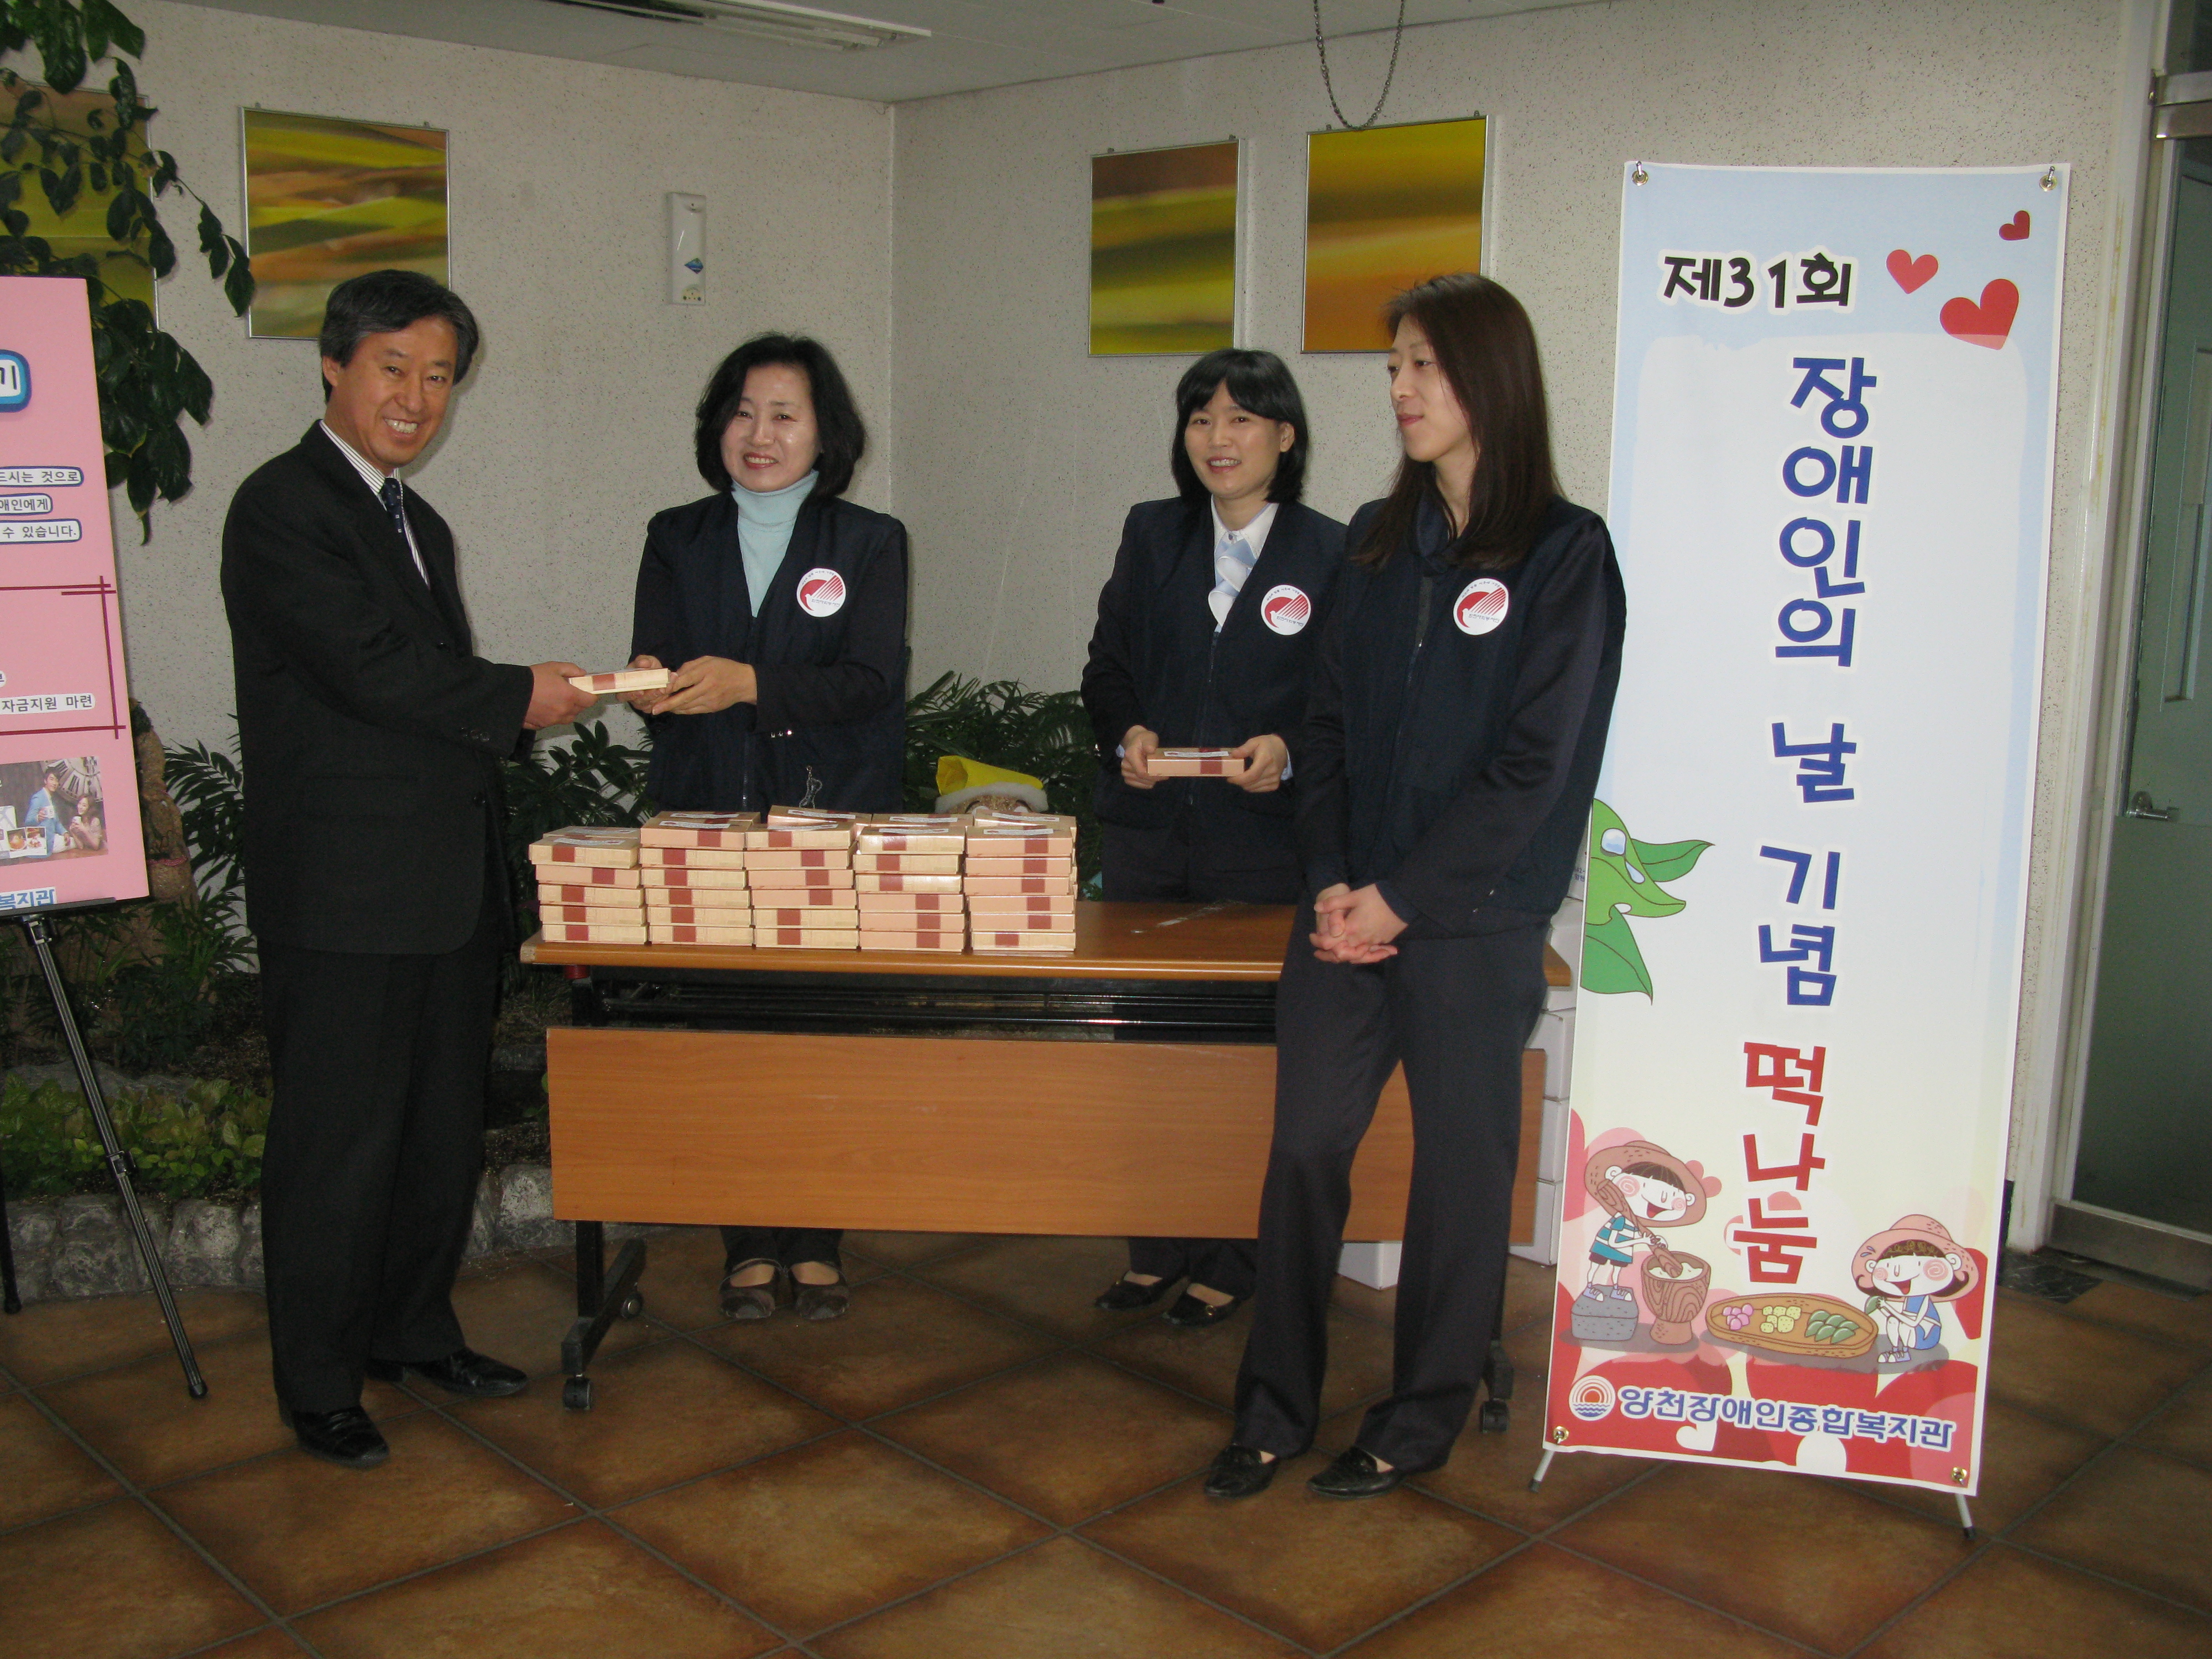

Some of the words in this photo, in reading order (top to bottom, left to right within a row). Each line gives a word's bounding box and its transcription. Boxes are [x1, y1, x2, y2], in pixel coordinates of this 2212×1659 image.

[1663, 252, 1851, 308] 제31회
[41, 471, 79, 483] 것으로
[2, 526, 14, 539] 수
[22, 525, 76, 538] 있습니다.
[1775, 357, 1877, 667] 장애인의
[2, 697, 57, 712] 자금지원
[66, 695, 92, 709] 마련
[1771, 722, 1857, 804] 날
[0, 889, 54, 909] 복지관
[1757, 844, 1840, 1006] 기념
[1733, 1041, 1826, 1284] 떡나눔
[1620, 1387, 1954, 1449] 양천장애인종합복지관
